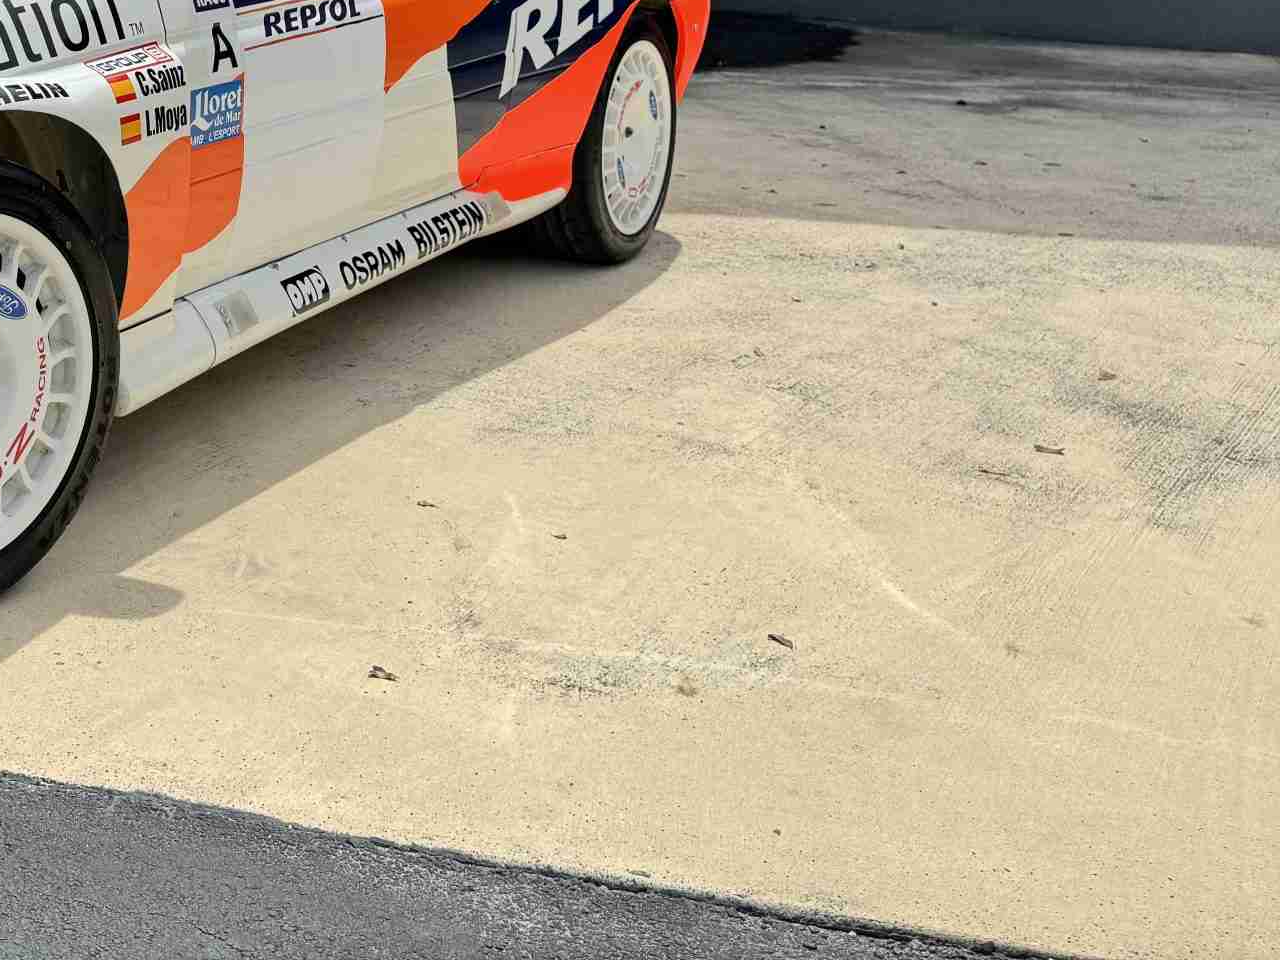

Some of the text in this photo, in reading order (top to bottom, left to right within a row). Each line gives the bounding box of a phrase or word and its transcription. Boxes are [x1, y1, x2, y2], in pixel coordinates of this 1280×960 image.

[212, 22, 239, 73] A
[134, 64, 187, 97] C.Sainz
[145, 104, 188, 137] L.Moya
[338, 240, 406, 290] OSRAM
[407, 201, 484, 259] BILSTEIN
[30, 336, 47, 422] RACING
